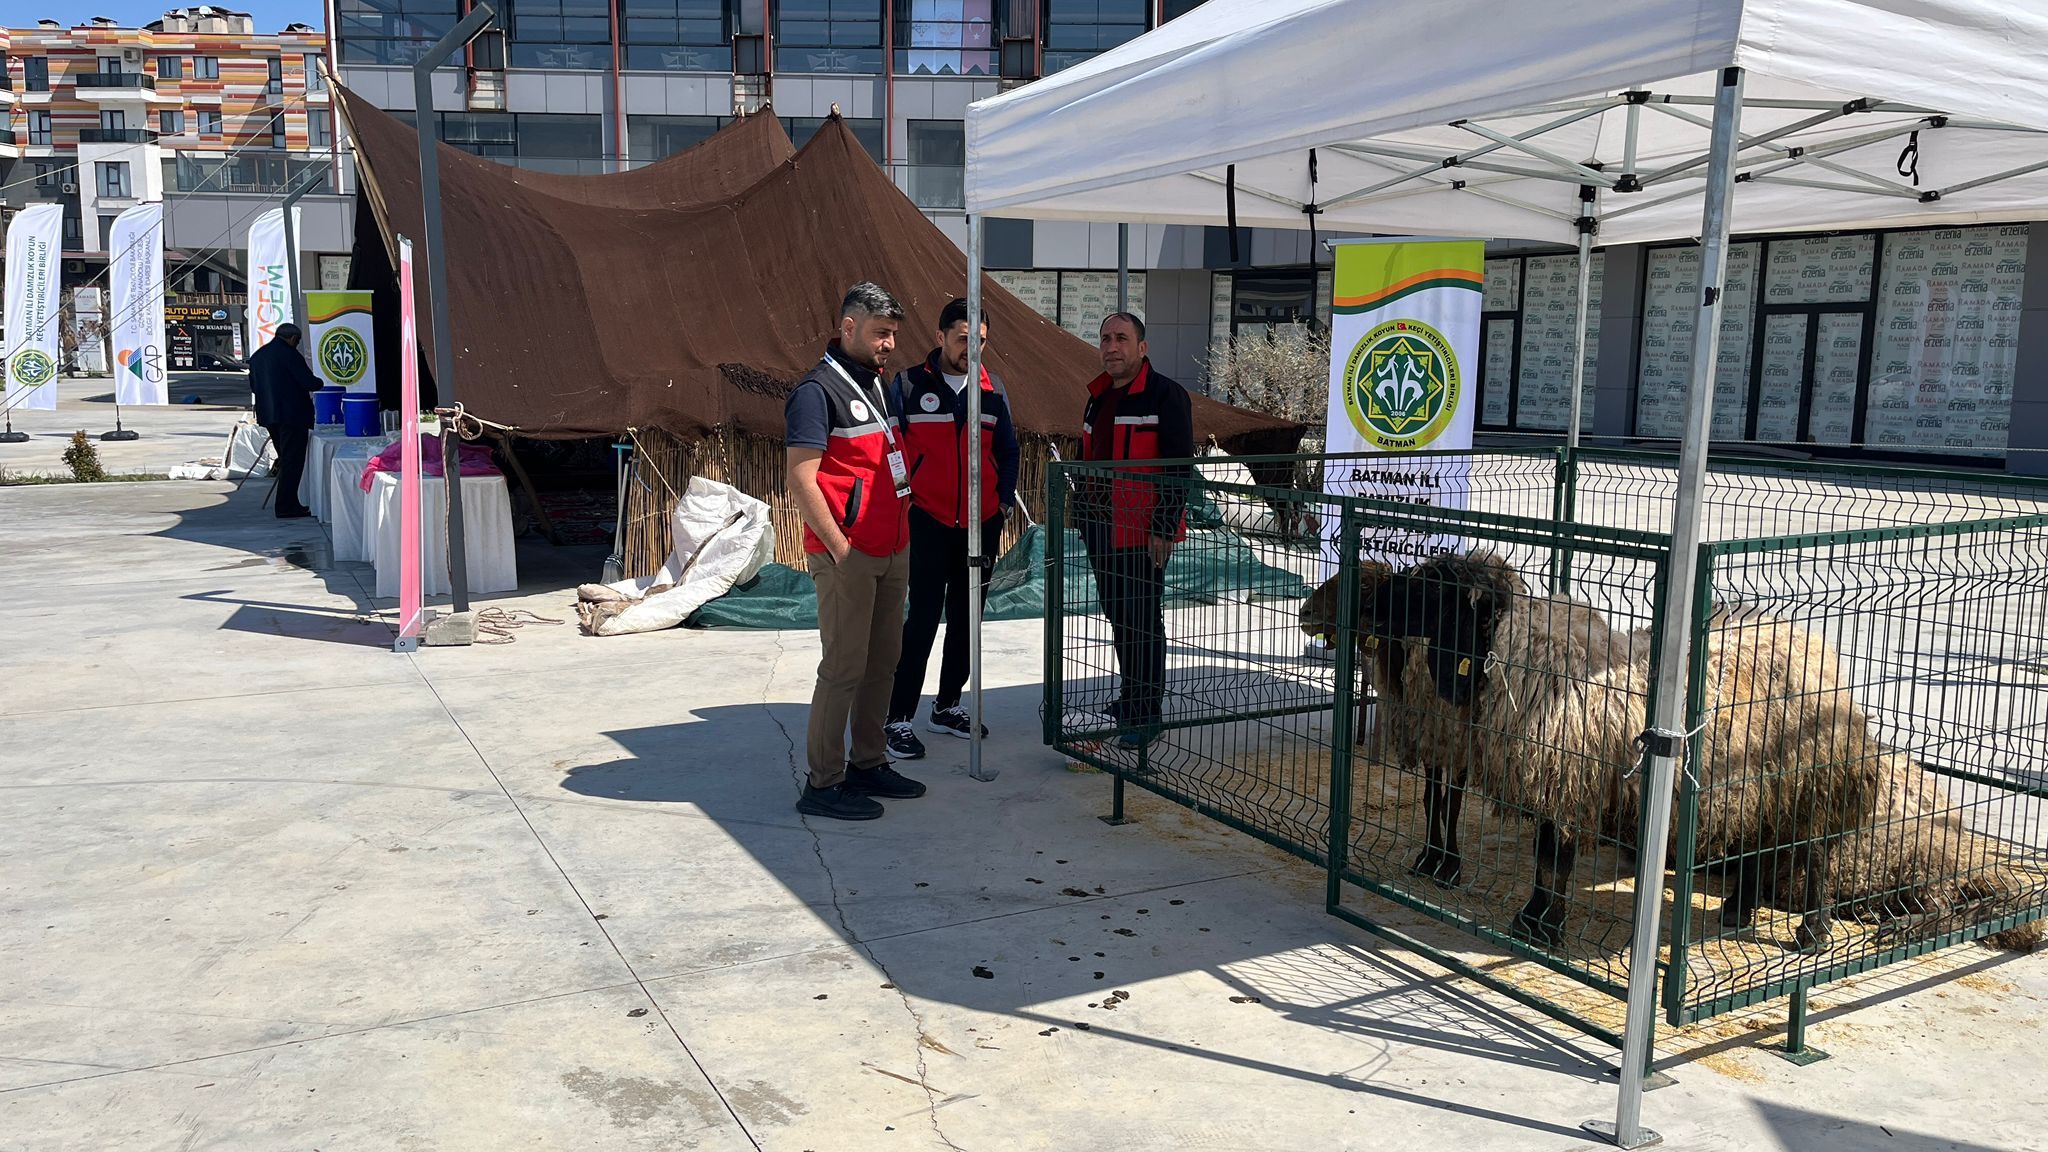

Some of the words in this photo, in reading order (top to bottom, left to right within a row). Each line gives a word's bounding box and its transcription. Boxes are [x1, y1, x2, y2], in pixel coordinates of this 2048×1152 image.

[1934, 229, 1962, 240] erzenia
[2000, 225, 2030, 236] erzenia
[27, 235, 36, 262] KOYUN
[1964, 246, 1992, 256] erzenia
[37, 241, 46, 268] BİRLİĞİ
[1831, 250, 1856, 260] erzenia
[1898, 249, 1924, 260] erzenia
[1801, 269, 1826, 278] erzenia
[1932, 265, 1958, 276] erzenia
[1996, 262, 2026, 274] erzenia
[26, 263, 35, 299] DAMIZLIK
[1894, 284, 1920, 295] erzenia
[1960, 282, 1988, 293] erzenia
[1927, 302, 1954, 312] erzenia
[1958, 298, 1991, 306] RAMADA
[1992, 299, 2021, 310] erzenia
[1890, 319, 1917, 330] erzenia
[1956, 318, 1984, 330] erzenia
[1373, 325, 1395, 338] KOYUN
[1924, 337, 1951, 348] erzenia
[1351, 337, 1373, 364] DAMIZLIK
[1347, 364, 1355, 376] İLİ
[1408, 324, 1424, 334] KEÇİ
[1445, 383, 1456, 411] BİRLİĞİ
[1886, 364, 1912, 374] erzenia
[1952, 365, 1980, 376] erzenia
[1346, 379, 1354, 406] BATMAN
[1920, 382, 1946, 393] erzenia
[1948, 400, 1976, 412] erzenia
[1916, 418, 1942, 428] erzenia
[1980, 420, 2010, 432] erzenia
[1376, 436, 1416, 448] BATMAN
[1878, 432, 1906, 444] erzenia
[1944, 436, 1973, 448] erzenia
[1352, 469, 1415, 487] BATMAN
[1419, 471, 1441, 488] İLİ
